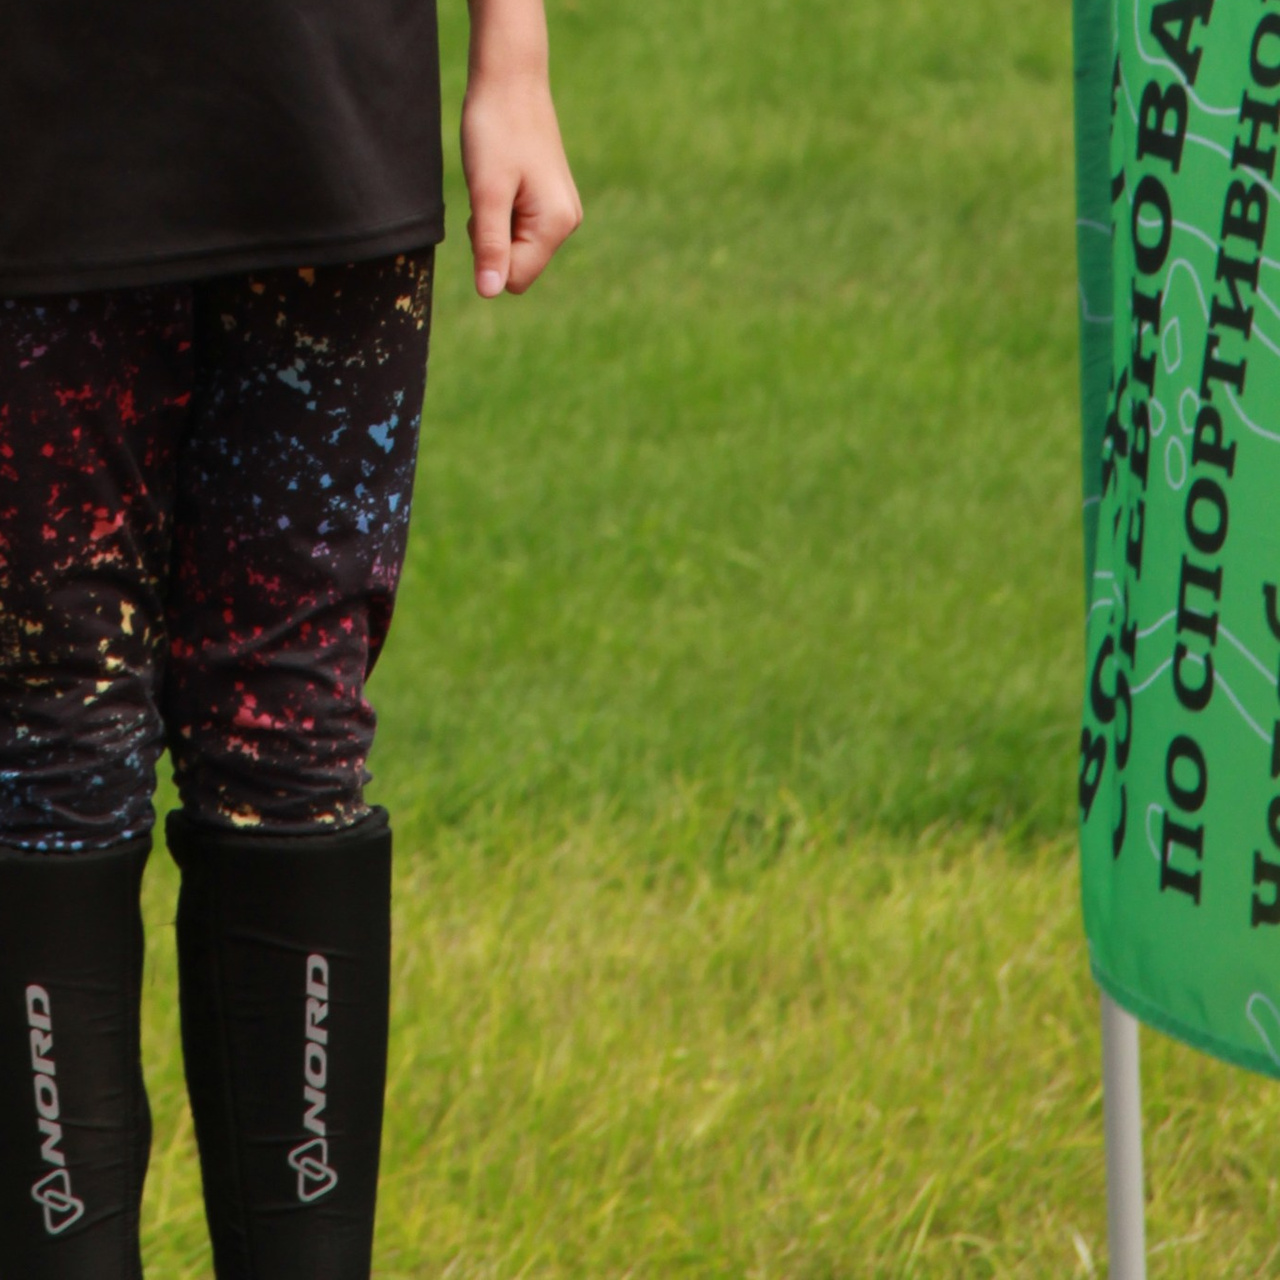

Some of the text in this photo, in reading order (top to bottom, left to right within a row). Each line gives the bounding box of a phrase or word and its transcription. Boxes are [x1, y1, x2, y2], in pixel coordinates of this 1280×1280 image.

[1157, 734, 1208, 907] ПО
[25, 984, 66, 1167] NORD
[302, 953, 330, 1137] NORD
